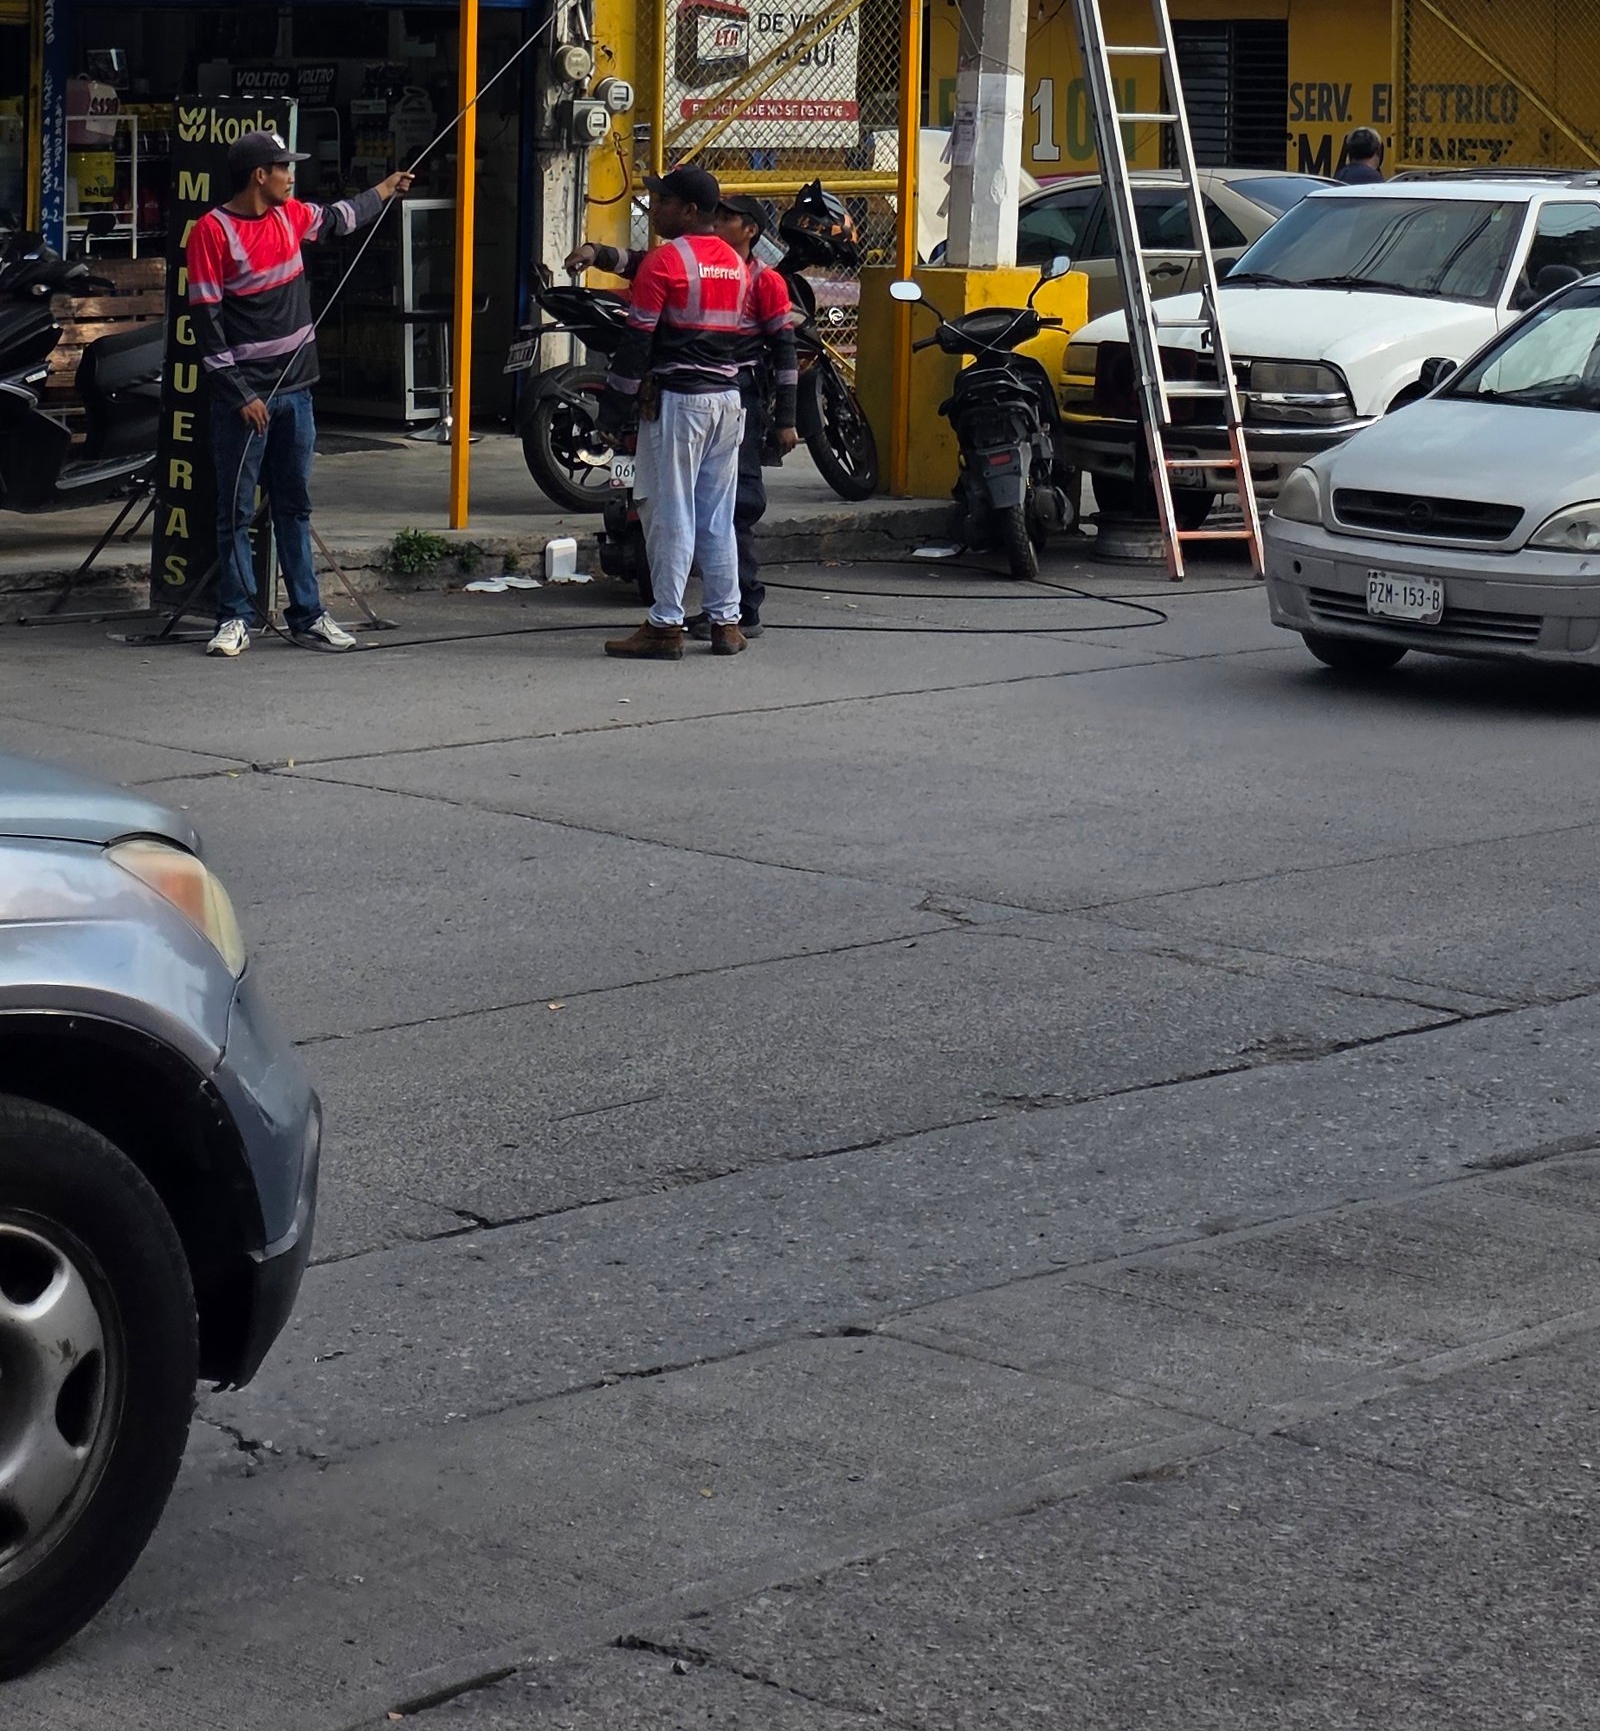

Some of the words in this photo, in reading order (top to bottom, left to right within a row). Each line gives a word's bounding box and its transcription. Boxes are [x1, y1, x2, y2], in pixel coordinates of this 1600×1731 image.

[758, 13, 784, 33] DE
[236, 71, 289, 87] VOLTRO
[1289, 83, 1353, 123] SERV.
[1369, 581, 1440, 610] PZM-153-B
